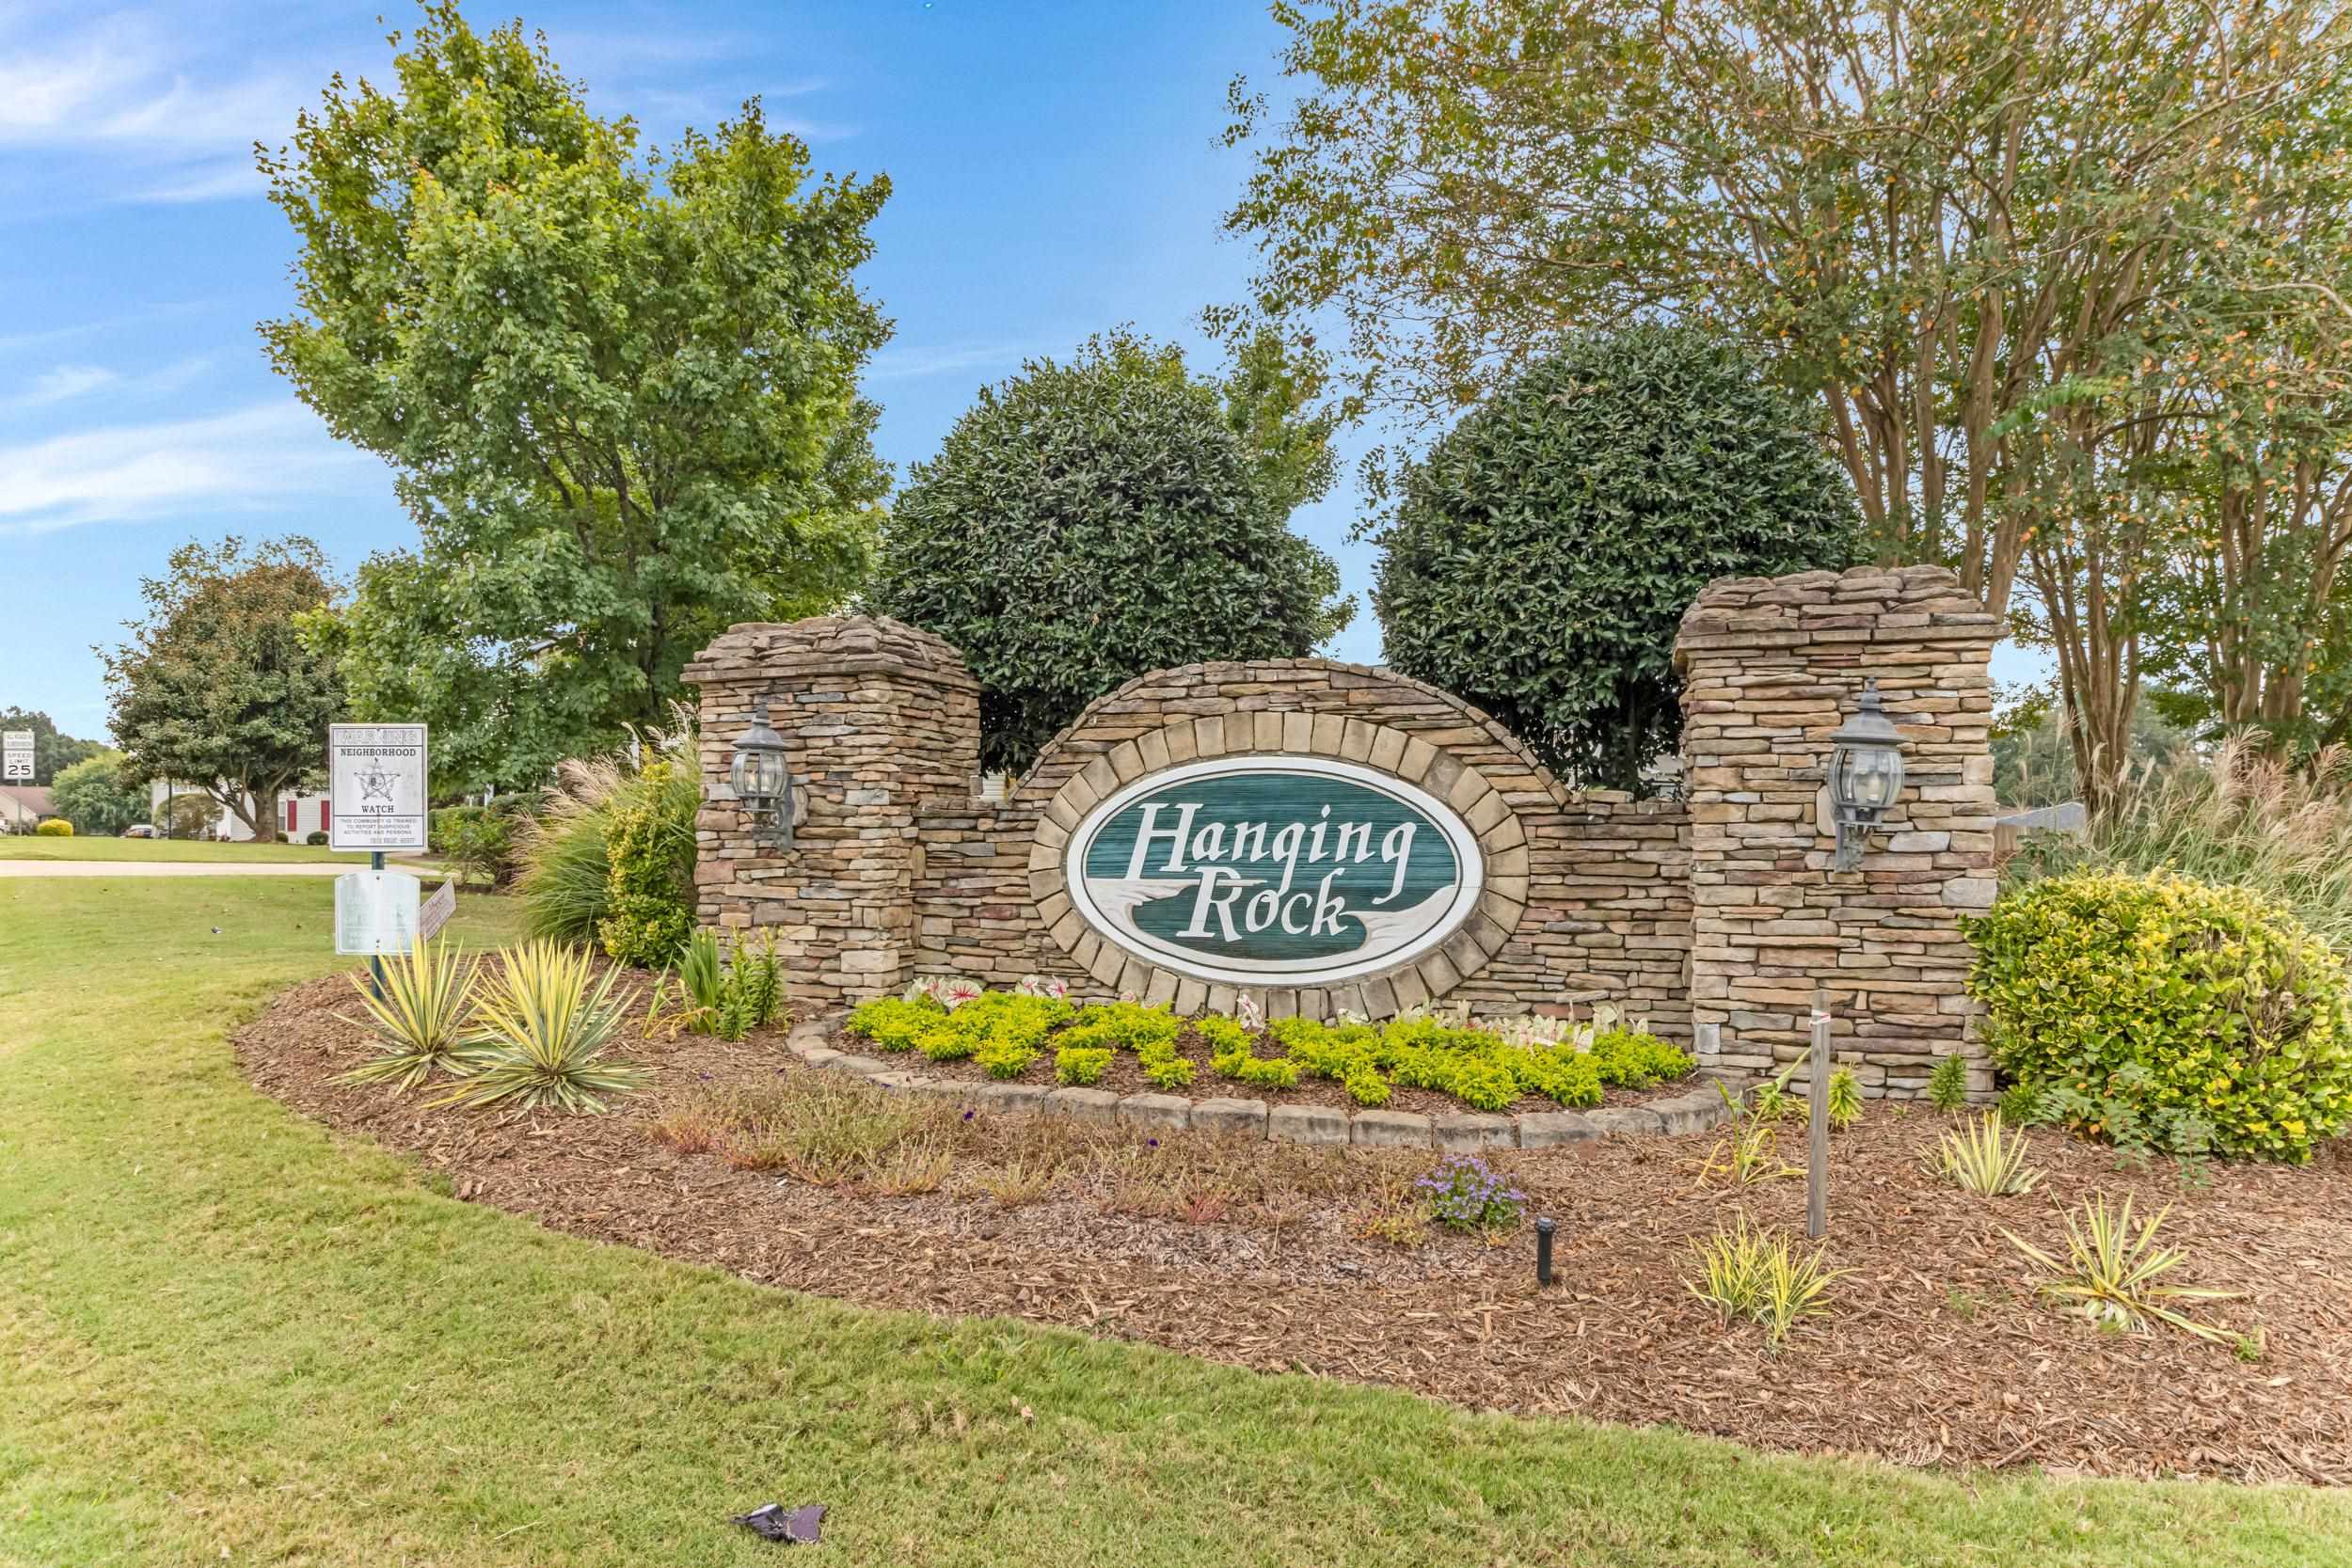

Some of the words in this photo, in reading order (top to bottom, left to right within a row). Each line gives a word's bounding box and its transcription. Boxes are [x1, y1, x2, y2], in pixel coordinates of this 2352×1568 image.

[341, 748, 417, 756] NEIGHBORHOOD
[8, 765, 31, 776] 25
[361, 805, 394, 814] WATCH
[1123, 802, 1417, 905] Hanging
[1176, 866, 1349, 942] Rock
